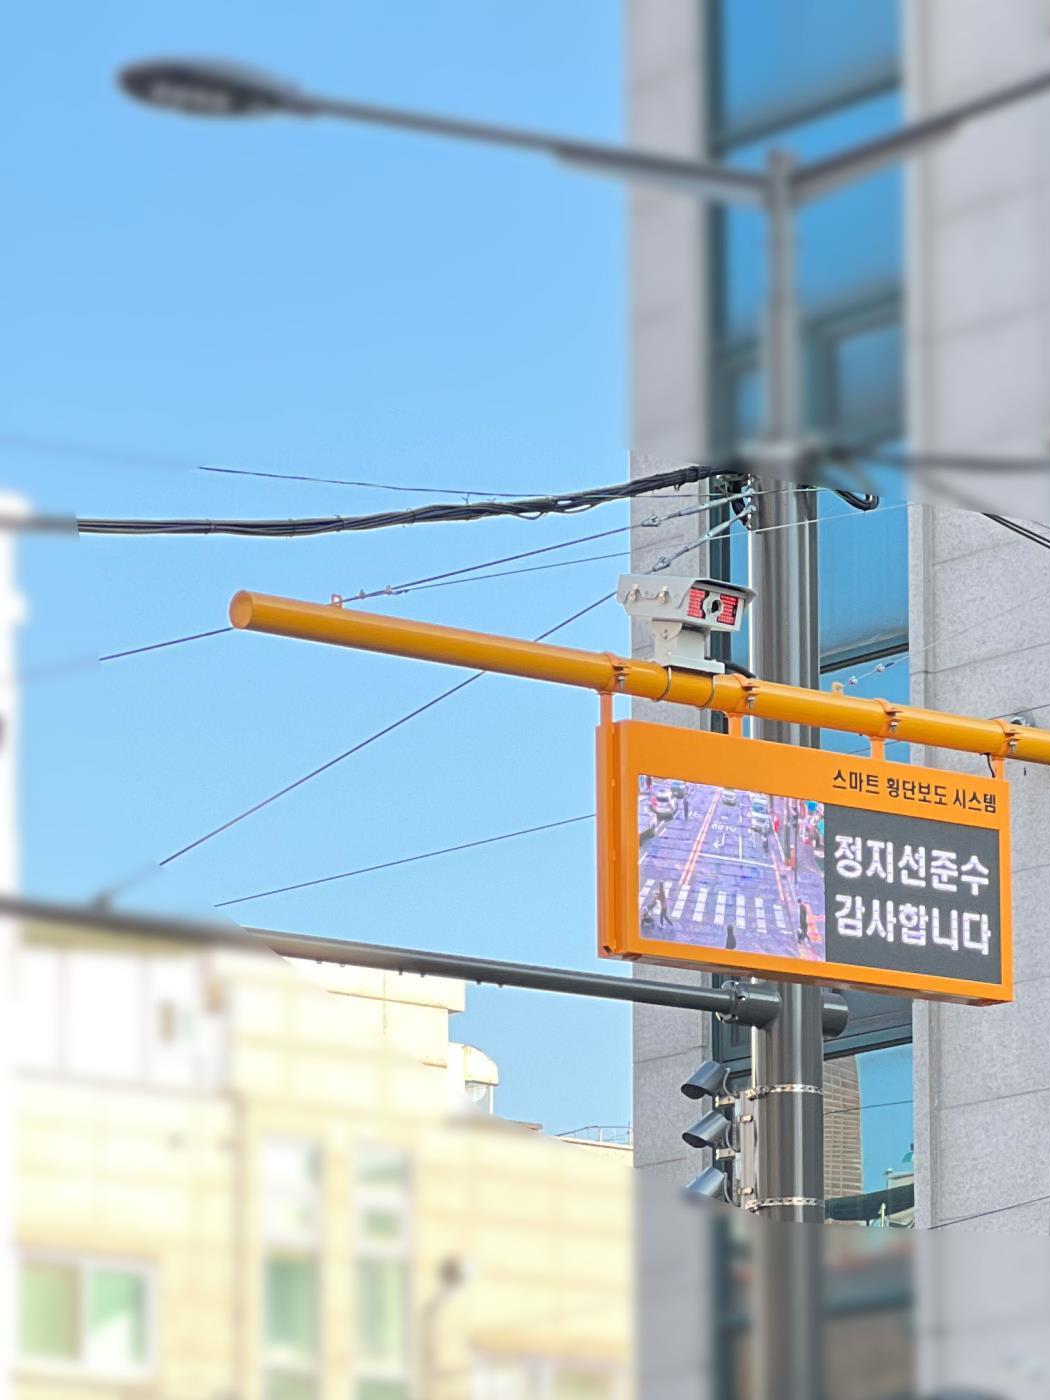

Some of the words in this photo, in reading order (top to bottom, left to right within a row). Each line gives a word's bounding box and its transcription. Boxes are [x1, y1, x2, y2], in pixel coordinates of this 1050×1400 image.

[832, 769, 880, 795] 스마트
[886, 777, 948, 806] 횡단보도
[953, 788, 997, 814] 시스템
[834, 835, 989, 896] 정지선준수
[835, 894, 991, 955] 감사합니다
